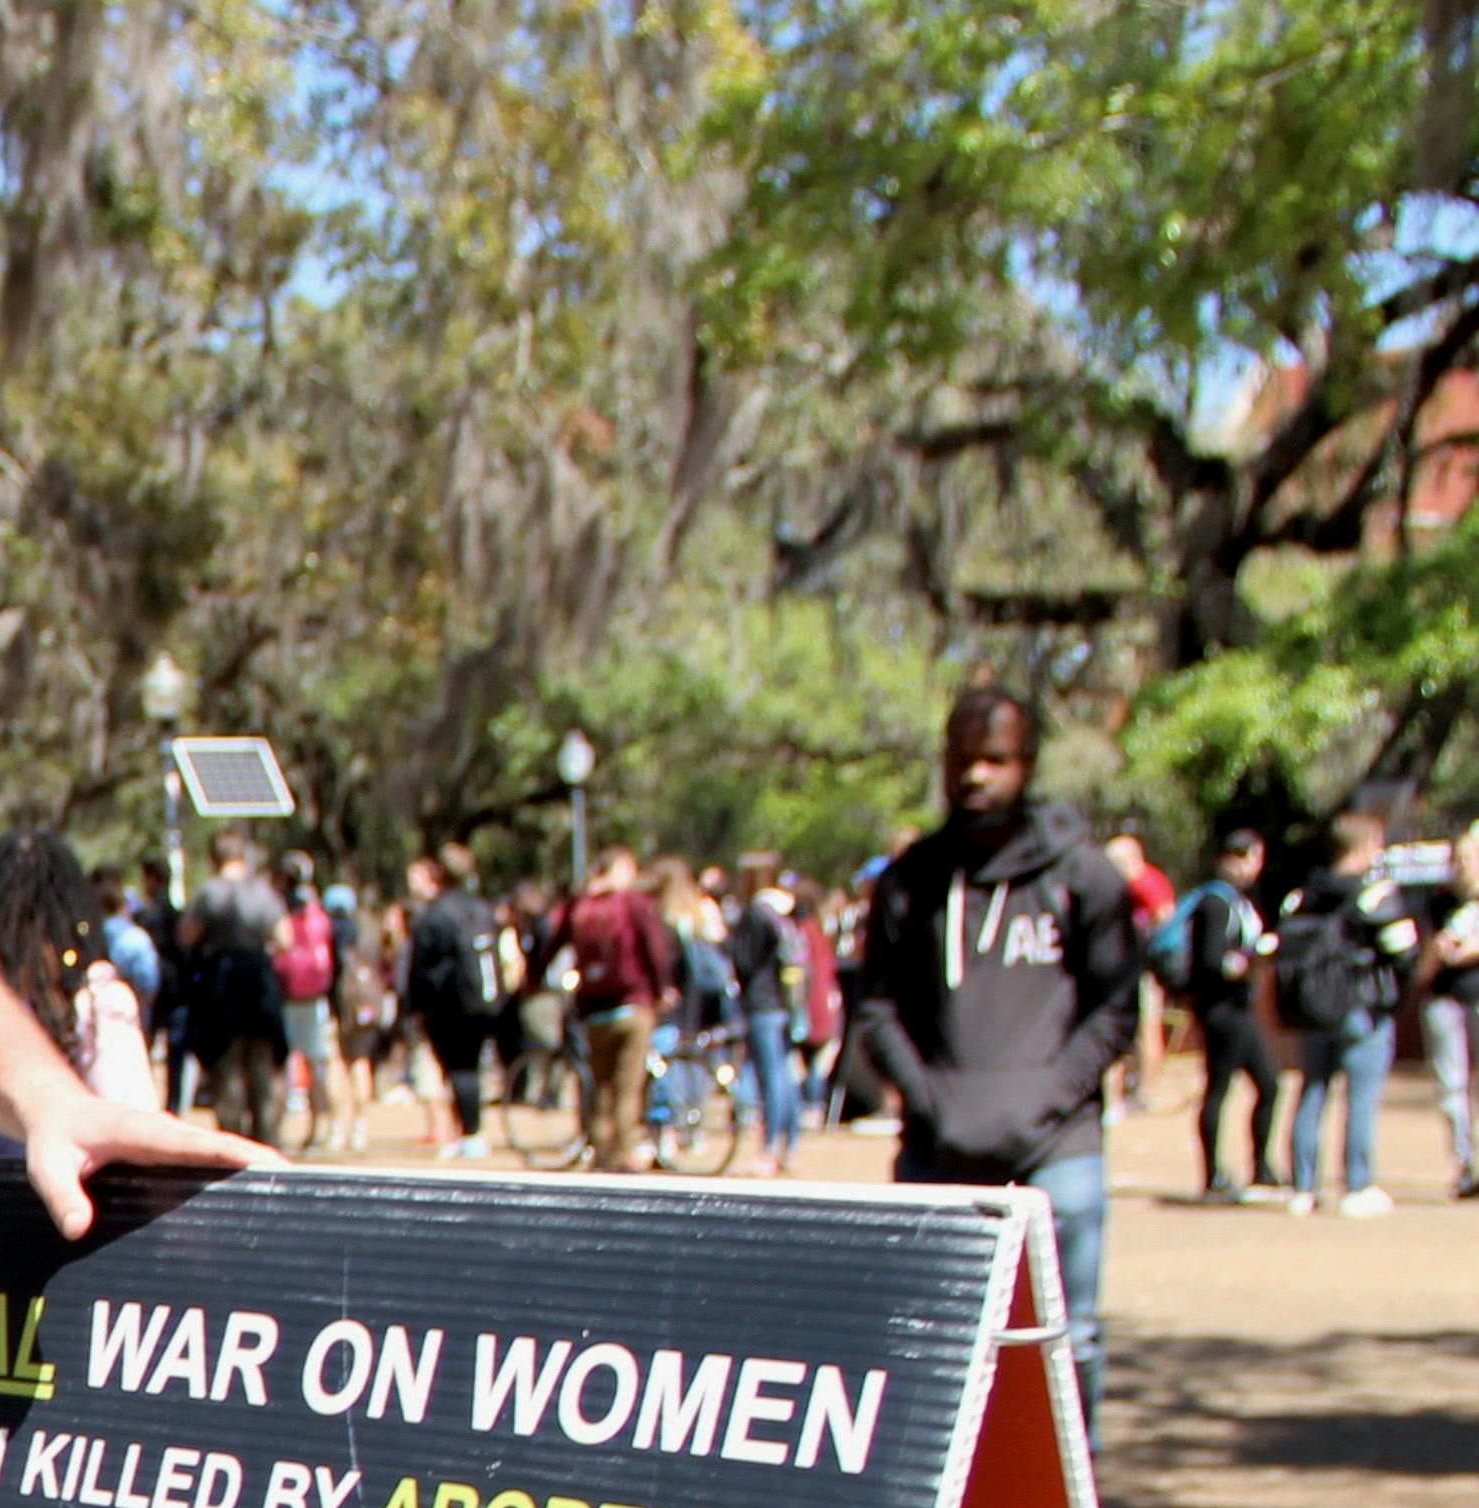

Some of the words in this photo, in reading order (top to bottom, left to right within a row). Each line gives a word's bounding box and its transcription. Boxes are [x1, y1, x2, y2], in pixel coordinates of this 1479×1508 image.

[87, 1299, 280, 1407] WAR
[301, 1318, 444, 1424] ON
[471, 1332, 888, 1475] WOMEN
